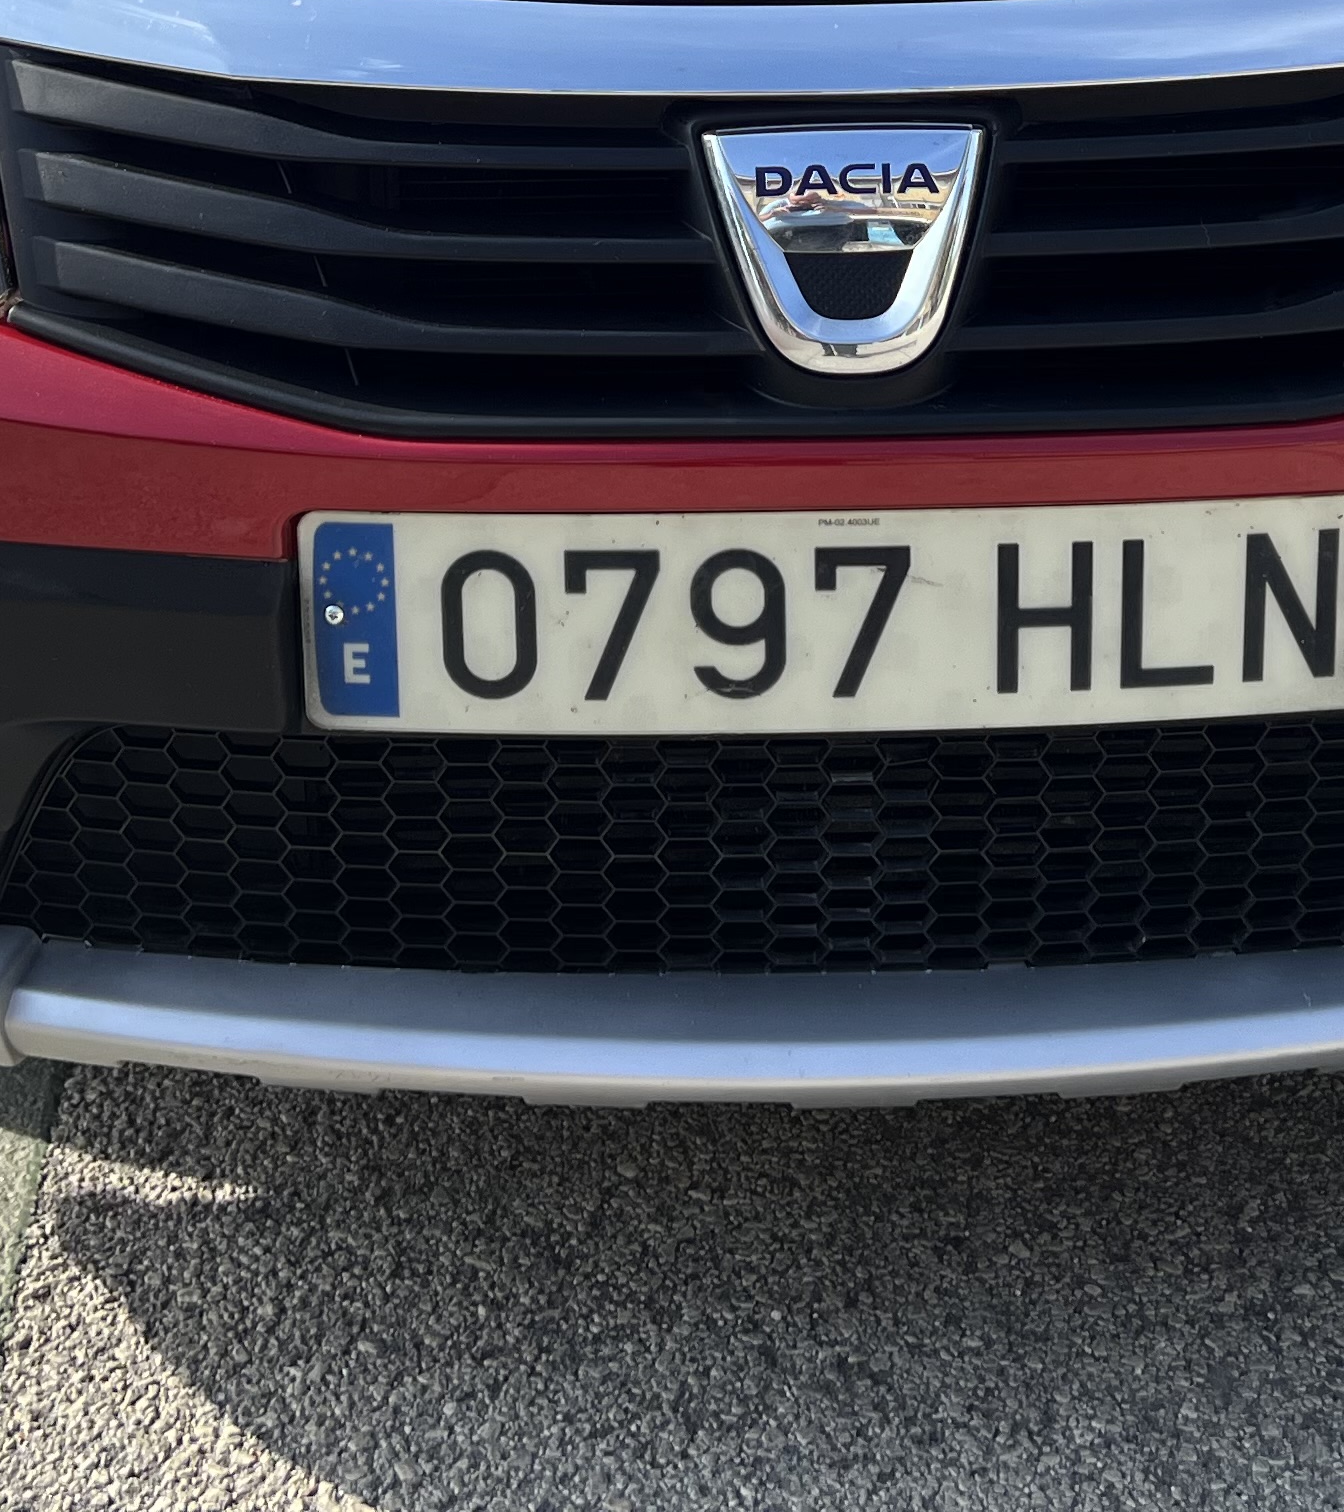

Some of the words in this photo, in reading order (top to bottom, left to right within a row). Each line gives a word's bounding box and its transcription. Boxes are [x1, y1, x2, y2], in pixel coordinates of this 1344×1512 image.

[755, 162, 940, 198] DACIA
[440, 545, 911, 701] 0797
[996, 528, 1341, 694] HLN
[343, 643, 371, 685] E
